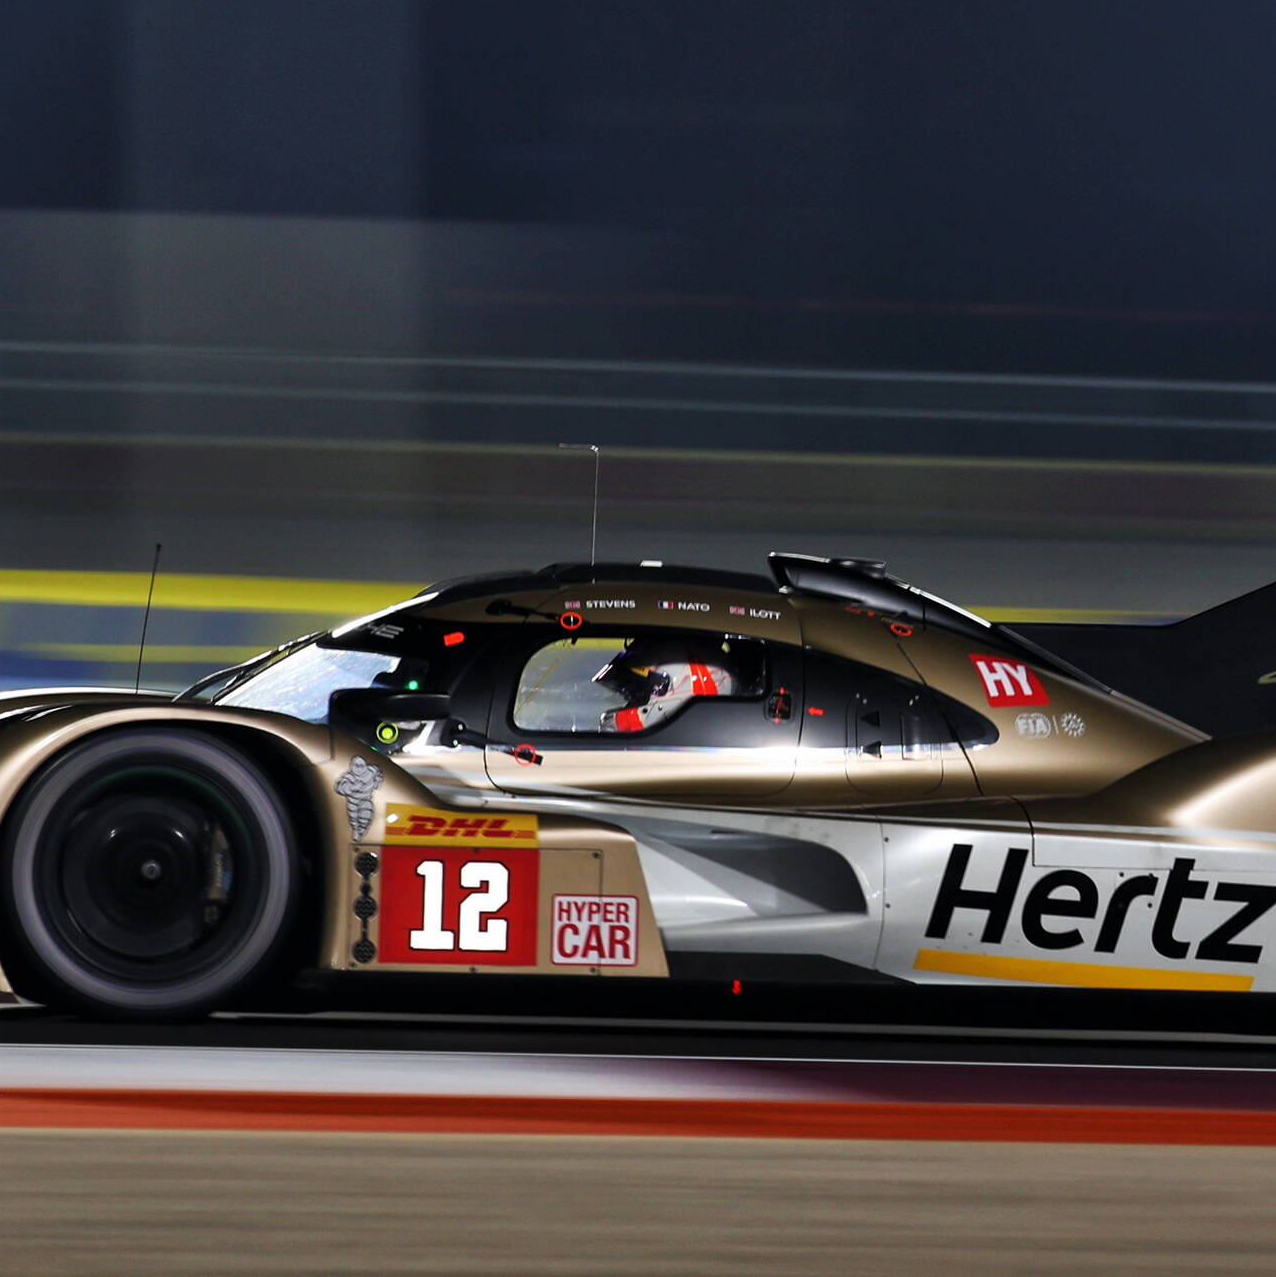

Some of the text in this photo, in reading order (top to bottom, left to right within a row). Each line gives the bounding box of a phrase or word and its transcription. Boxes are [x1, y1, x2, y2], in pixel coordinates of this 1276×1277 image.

[586, 600, 636, 609] STEVENS
[678, 602, 710, 612] NATO
[749, 609, 781, 620] ILOTT
[976, 660, 1033, 697] HY
[406, 815, 514, 838] DHL
[409, 860, 510, 952] 12
[558, 901, 630, 923] HYPER
[557, 923, 631, 959] CAR
